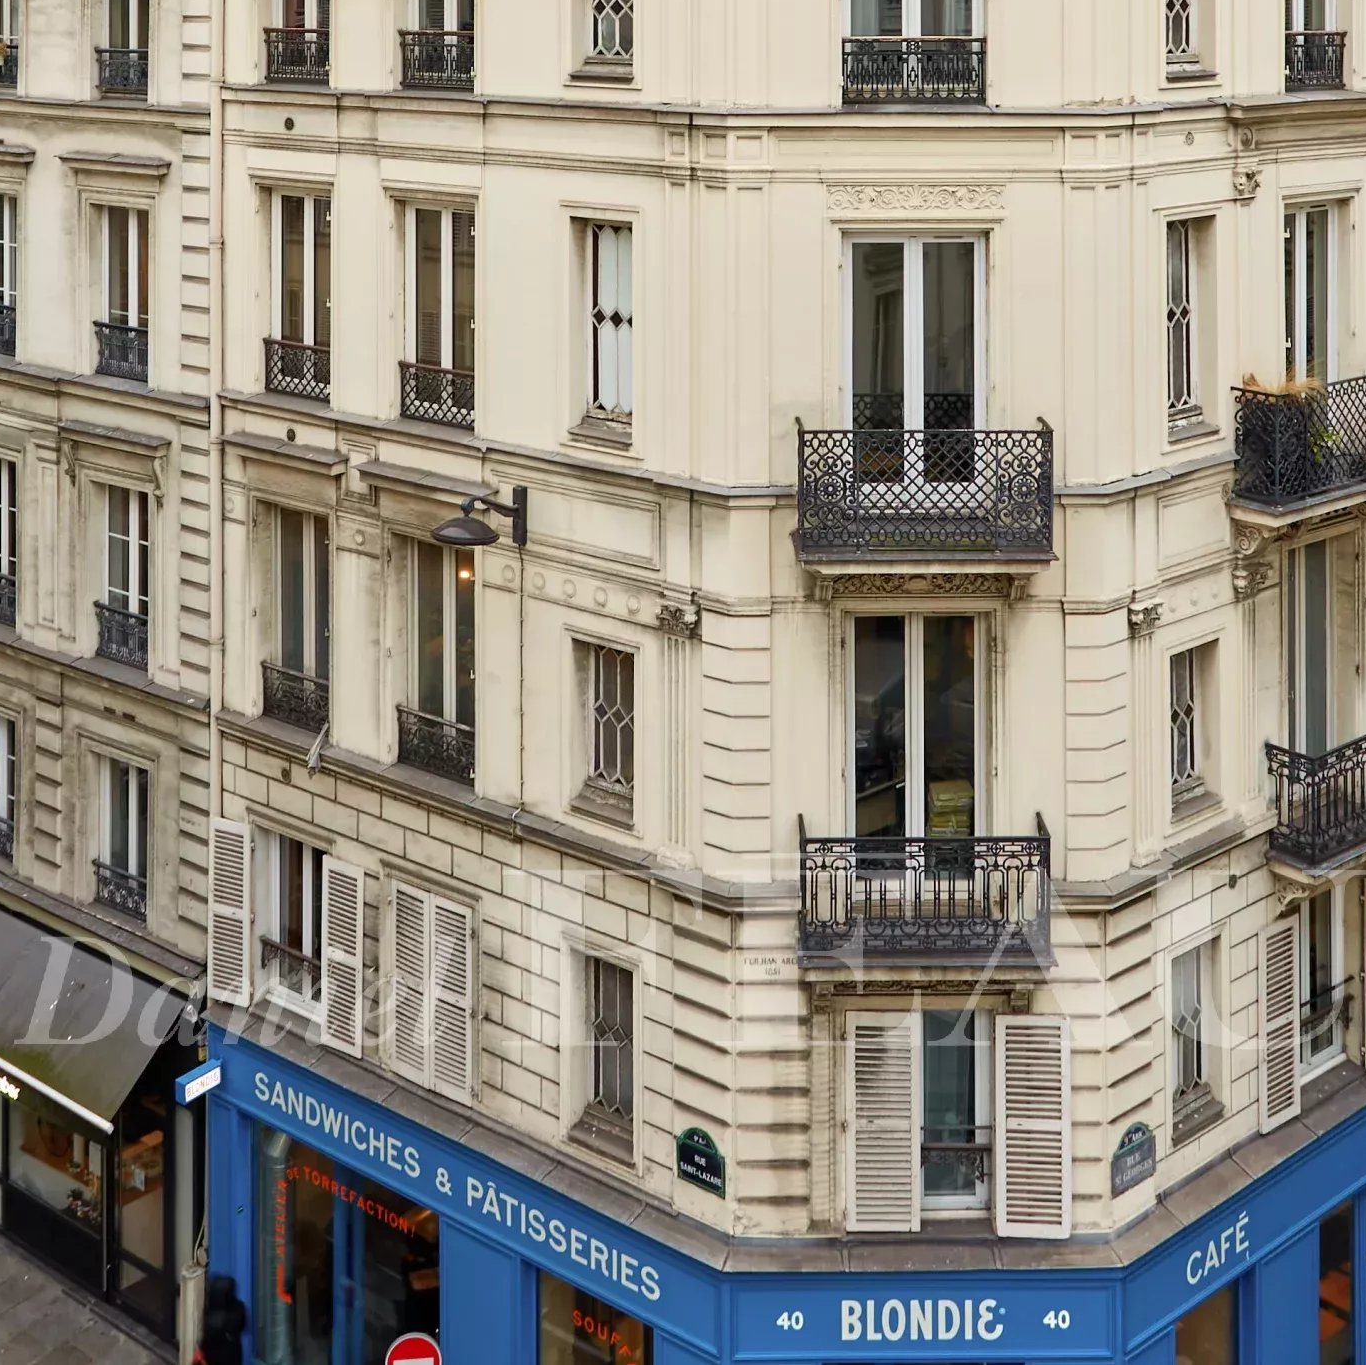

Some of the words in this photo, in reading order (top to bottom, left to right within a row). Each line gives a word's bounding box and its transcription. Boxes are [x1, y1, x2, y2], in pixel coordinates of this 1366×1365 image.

[680, 1161, 722, 1188] SAINT-LAZARE
[694, 1154, 706, 1167] RUE
[254, 1072, 421, 1179] SANDWICHES
[435, 1167, 453, 1197] &
[467, 1177, 661, 1302] PÂTISSERIES
[1186, 1210, 1250, 1286] CAFÉ
[776, 1310, 804, 1331] 40
[840, 1298, 1004, 1341] BLONDIE
[1042, 1309, 1071, 1330] 40
